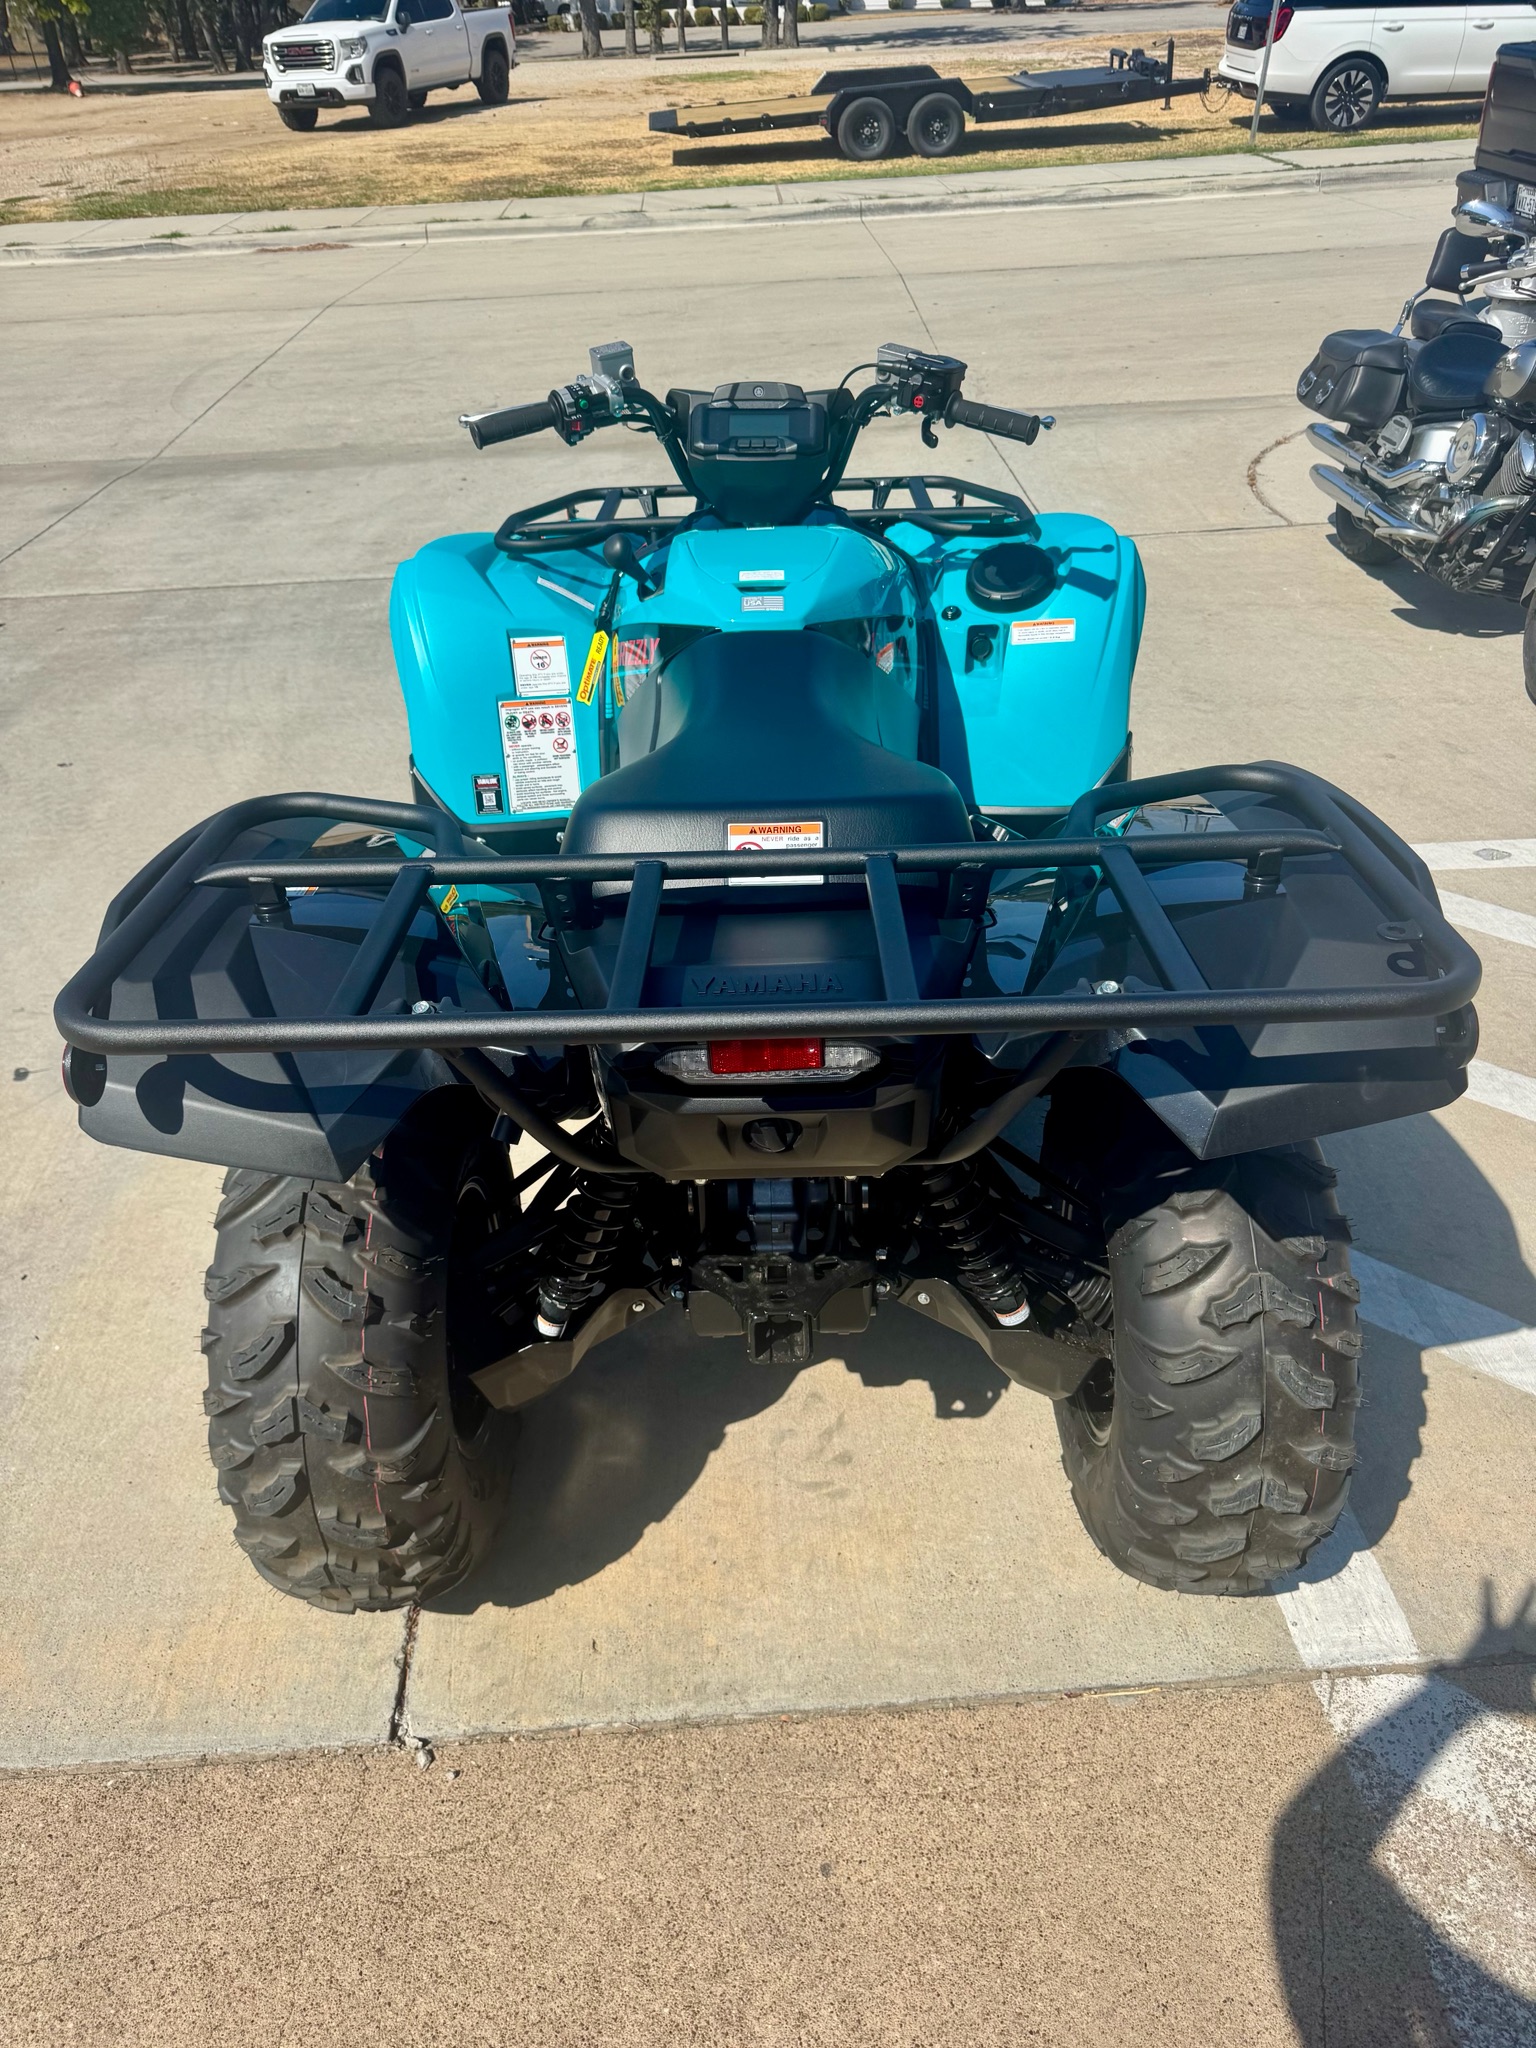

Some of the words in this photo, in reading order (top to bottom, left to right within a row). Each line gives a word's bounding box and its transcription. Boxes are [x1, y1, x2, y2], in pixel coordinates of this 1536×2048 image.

[595, 634, 605, 655] READY
[618, 637, 660, 667] RIZZLY
[758, 826, 802, 834] WARNING
[691, 973, 844, 996] YAMAHA
